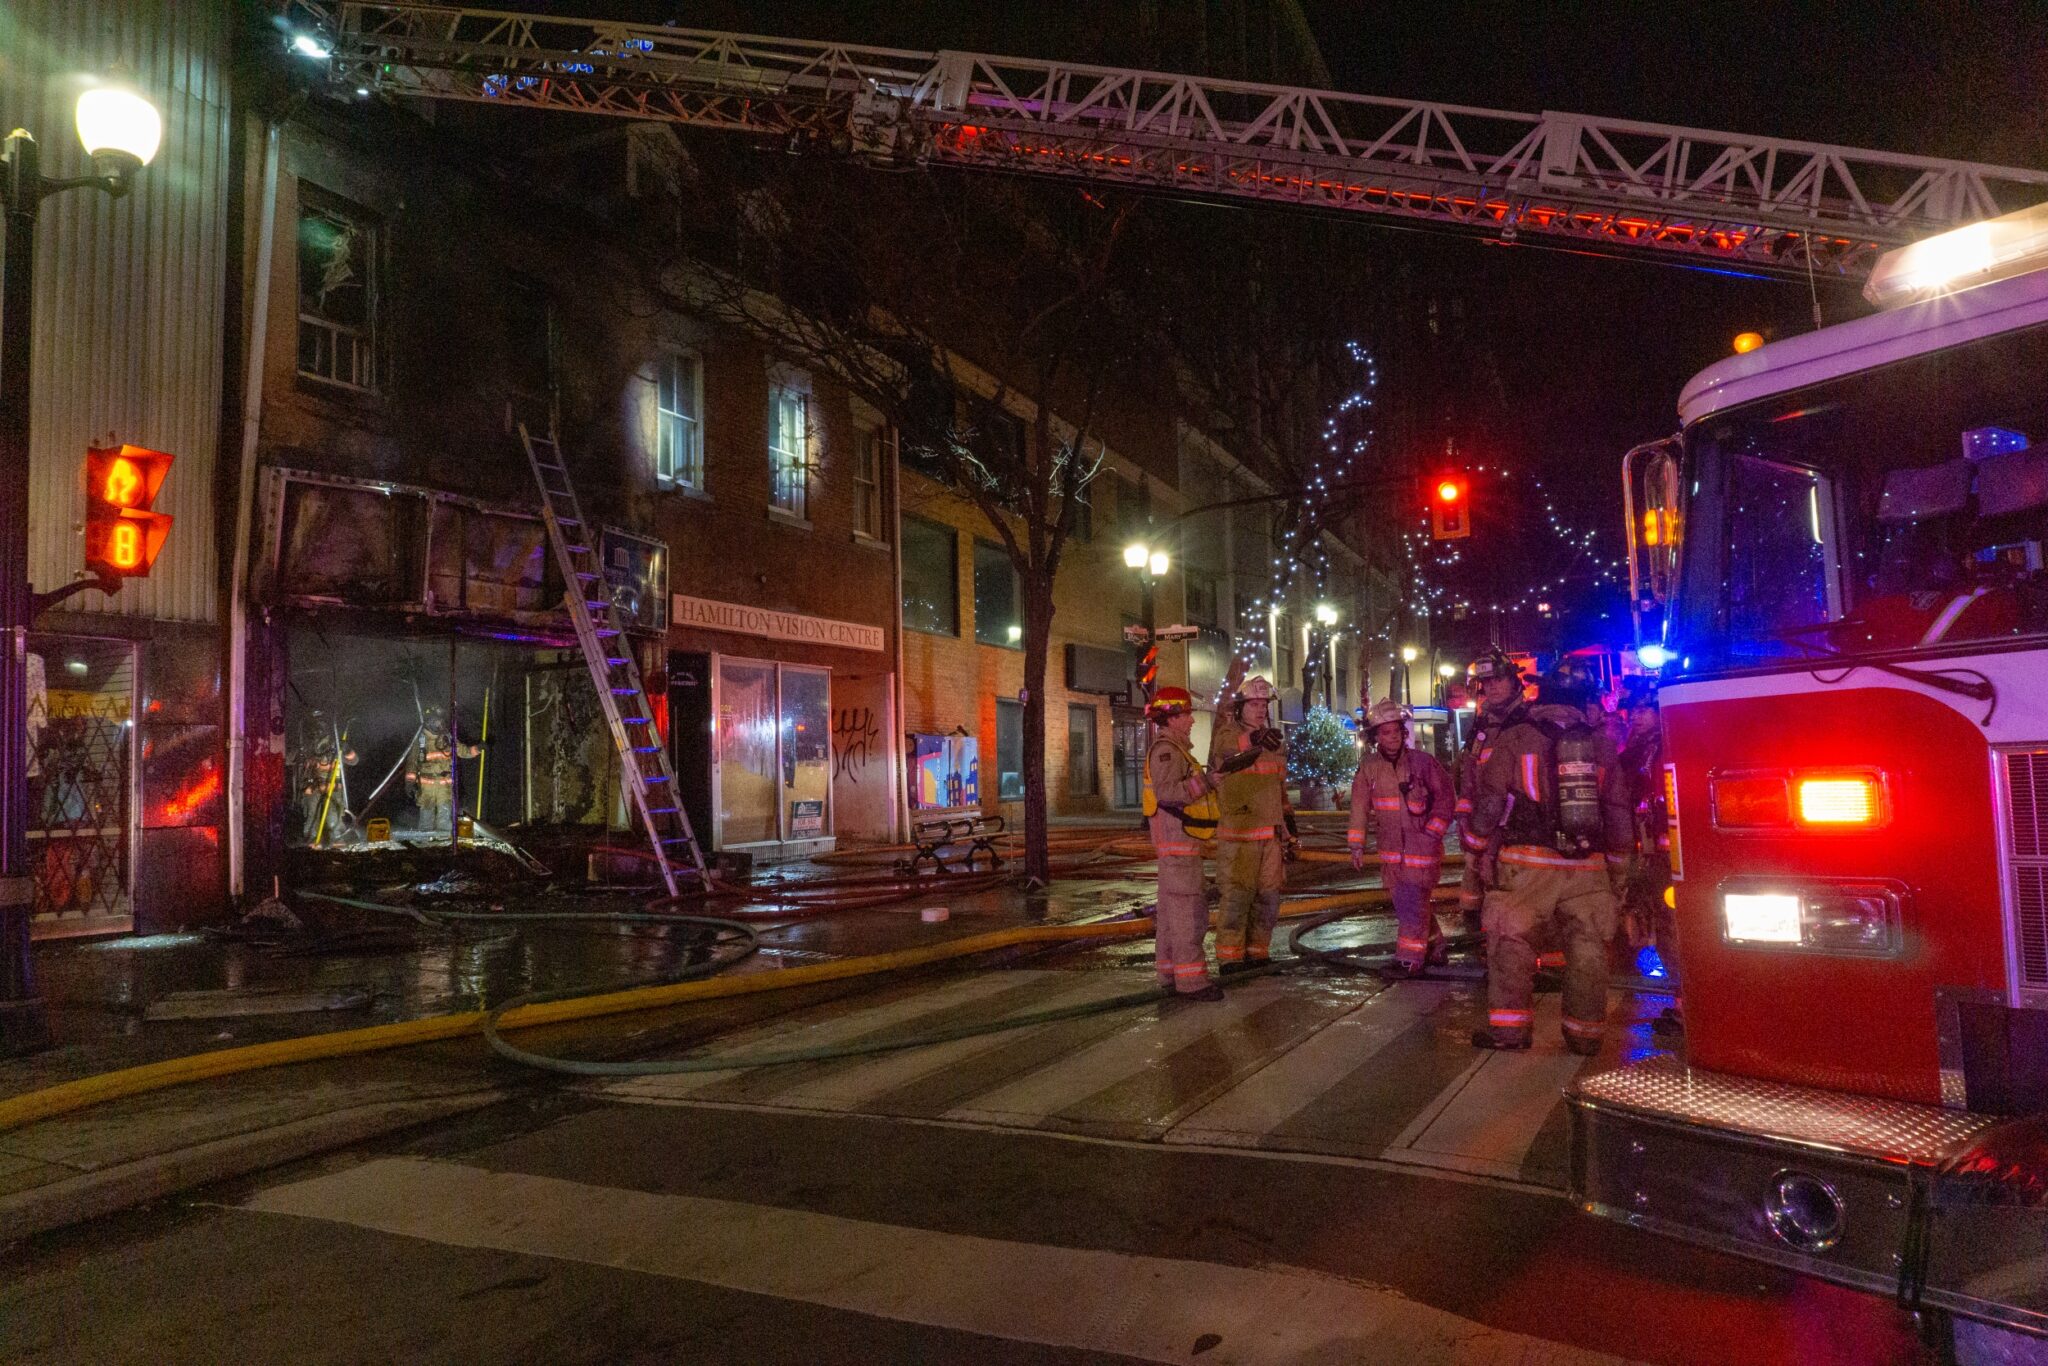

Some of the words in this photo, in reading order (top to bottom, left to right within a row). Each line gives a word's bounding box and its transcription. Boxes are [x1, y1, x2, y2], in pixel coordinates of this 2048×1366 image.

[681, 600, 771, 632] HAMILTON
[775, 615, 826, 639] VISION
[829, 623, 880, 647] CENTRE
